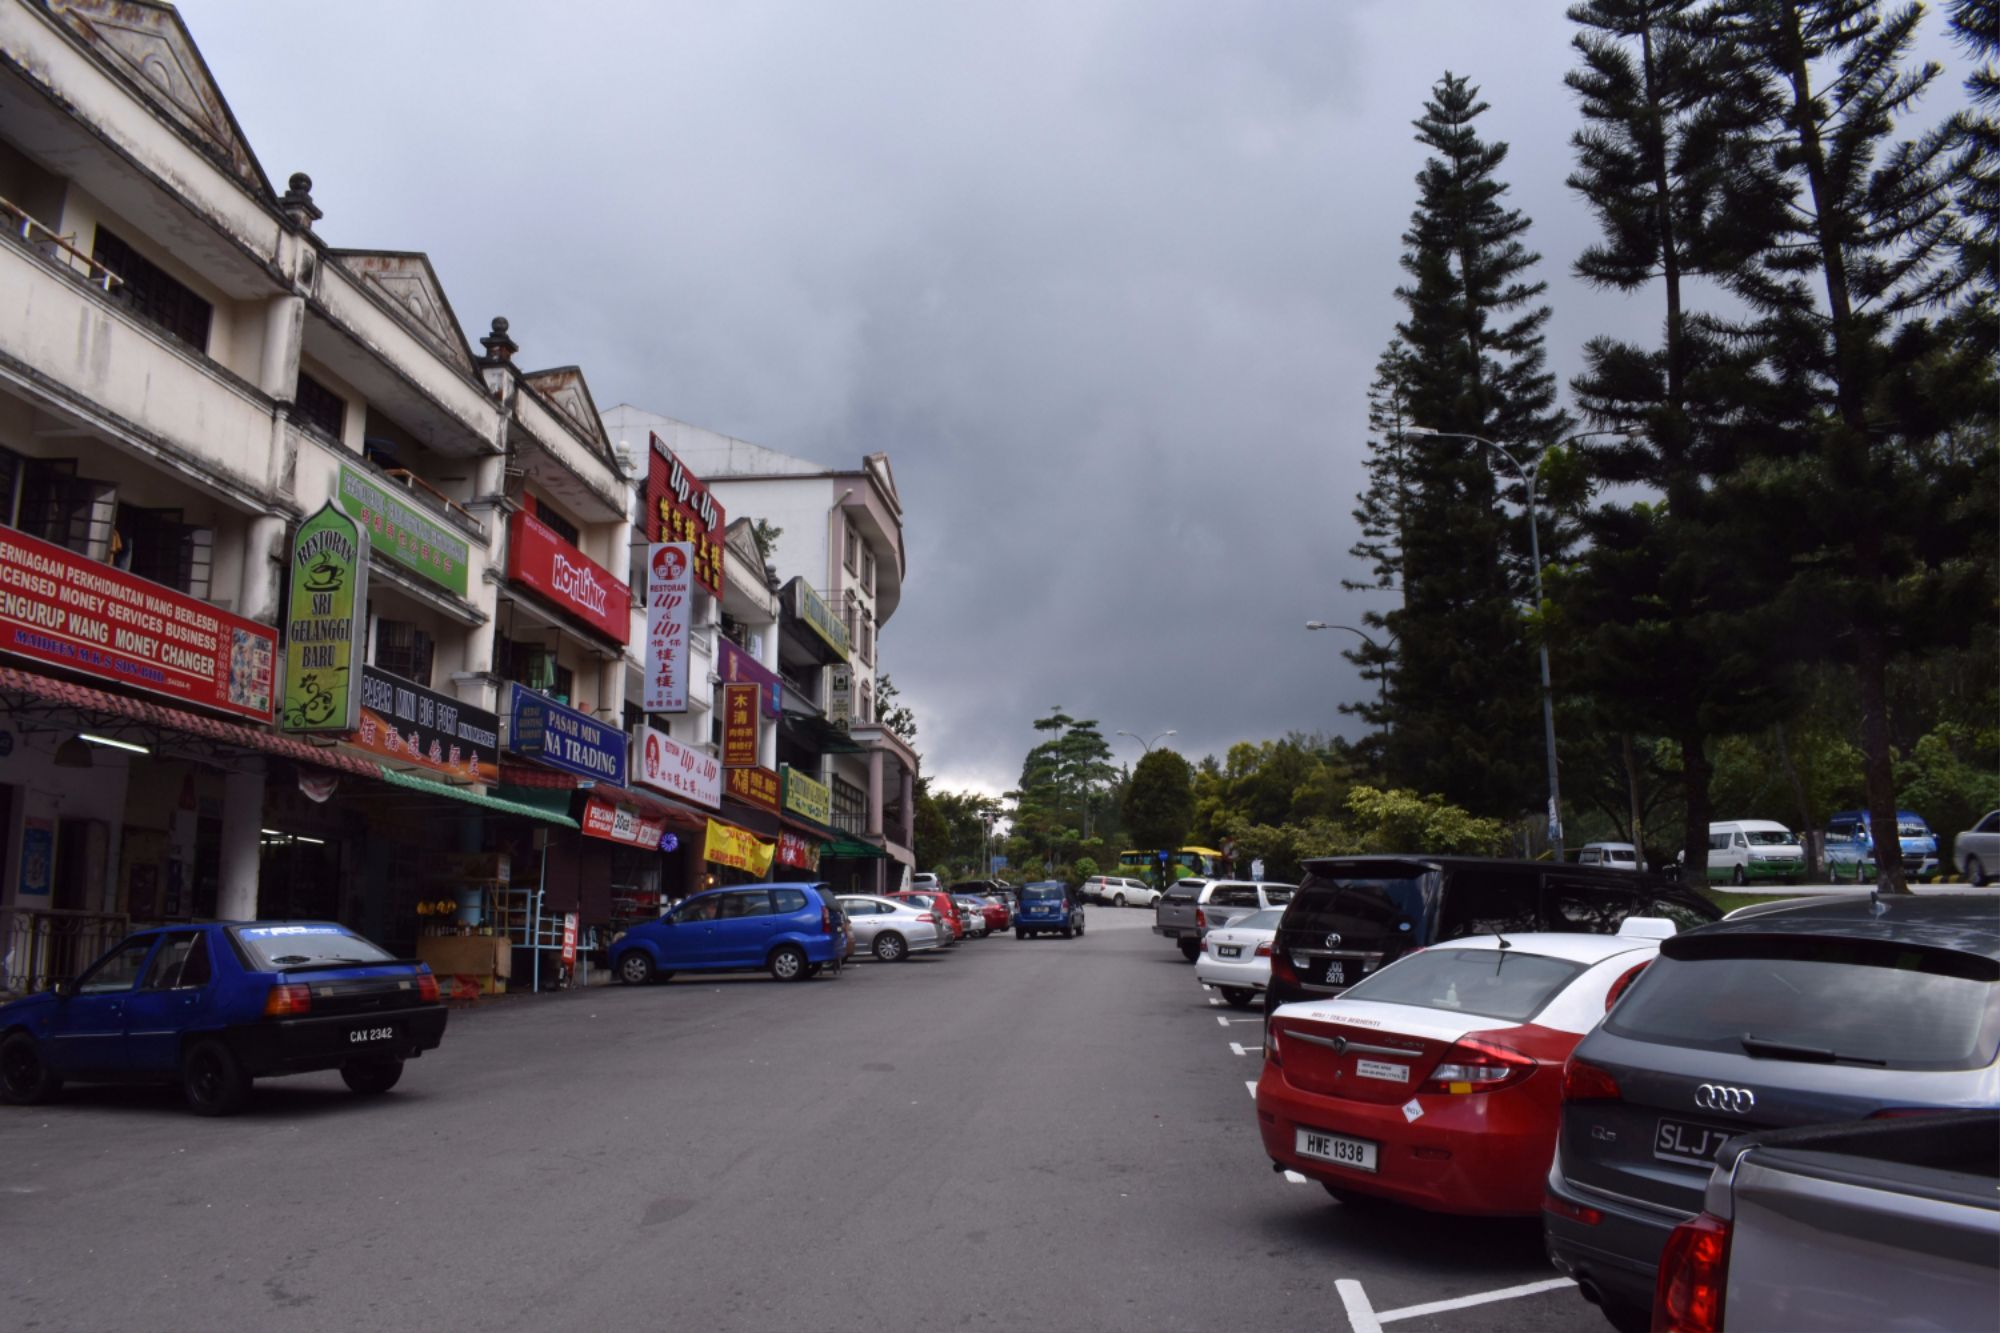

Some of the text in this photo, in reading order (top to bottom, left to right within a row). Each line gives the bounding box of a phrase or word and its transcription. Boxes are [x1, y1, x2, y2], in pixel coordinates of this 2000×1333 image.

[670, 460, 690, 503] Up
[700, 490, 717, 532] Up
[297, 529, 356, 568] RESTORAN
[66, 566, 144, 607] PERKHIDMATAN
[146, 594, 173, 617] WANG
[175, 605, 218, 634] BERLESEN
[311, 593, 332, 615] SRI
[650, 584, 687, 593] RESTORAN
[654, 593, 682, 610] Up
[60, 585, 105, 614] MONEY
[107, 601, 163, 634] SERVICES
[165, 622, 217, 652] BUSINESS
[291, 617, 351, 642] GELANGGI
[653, 621, 680, 639] Up
[69, 612, 109, 643] WANG
[115, 628, 159, 659] MONEY
[161, 643, 215, 677] CHANGER
[302, 643, 335, 668] BARU
[548, 709, 578, 737] PASAR
[580, 724, 601, 745] MINI
[544, 730, 616, 775] NA TRADING
[680, 748, 695, 773] Up
[704, 759, 717, 783] Up
[350, 1027, 393, 1042] CAX 2342
[1307, 1133, 1363, 1162] HWE 1338
